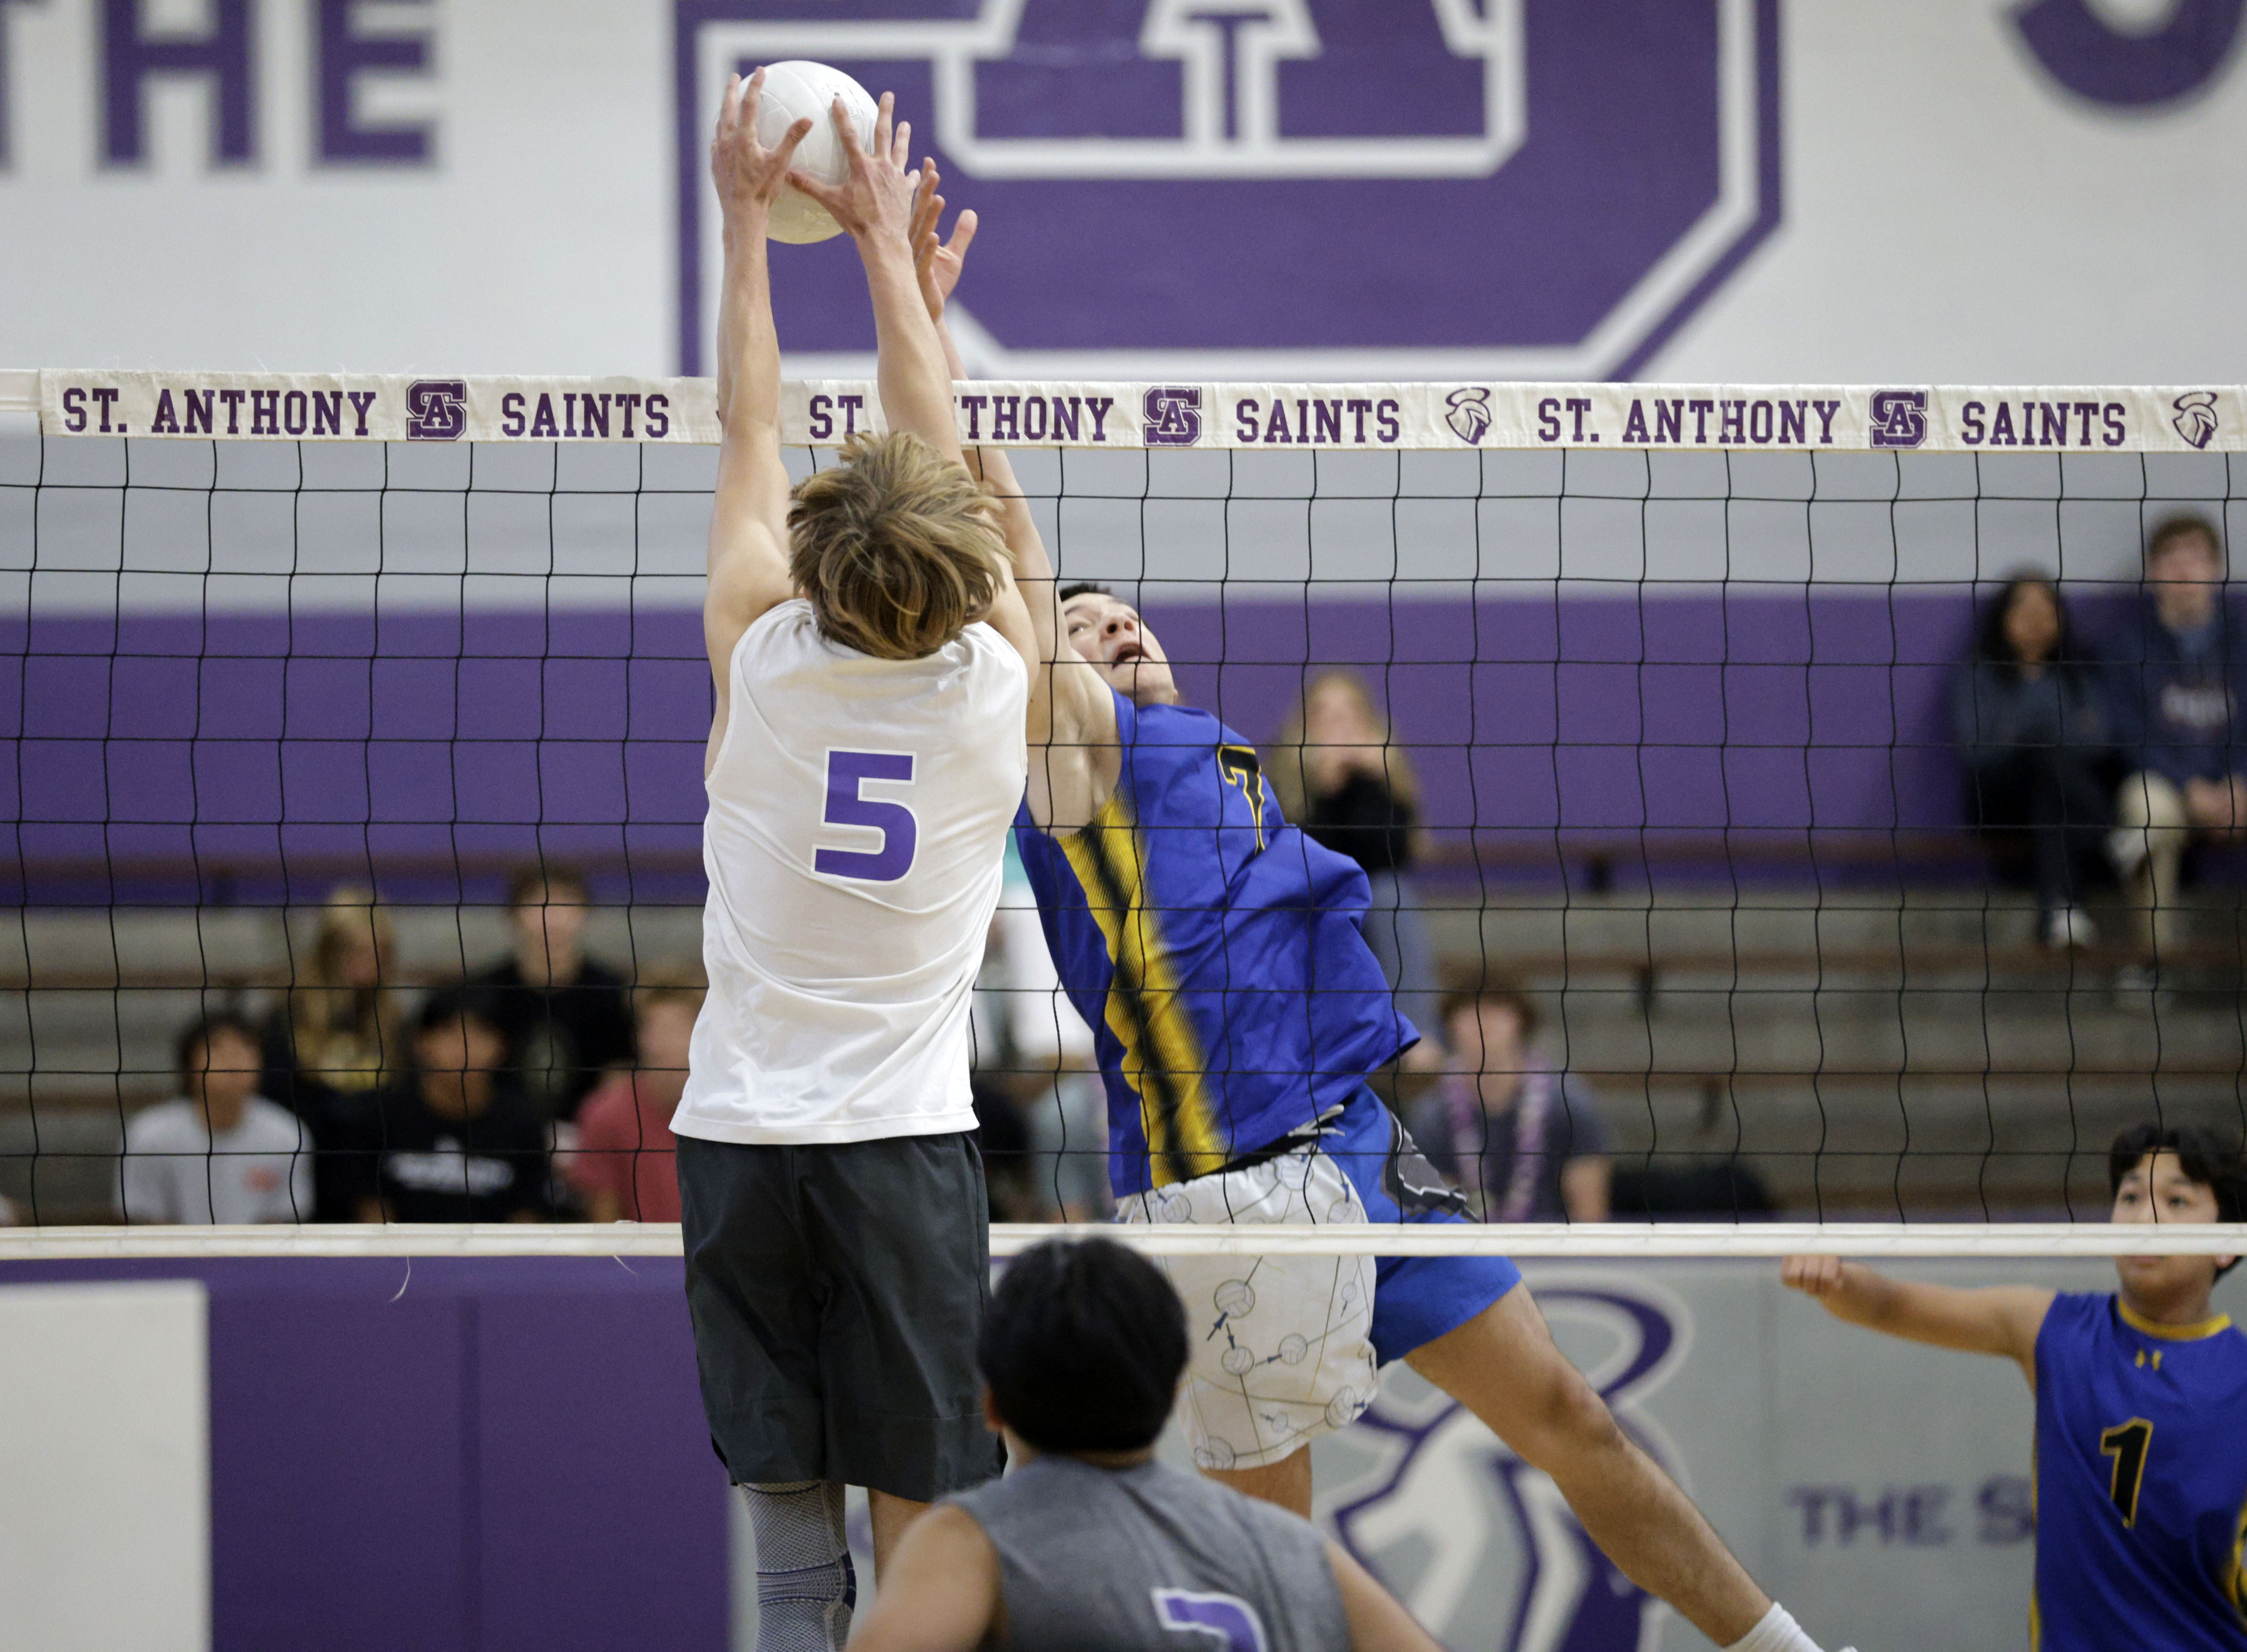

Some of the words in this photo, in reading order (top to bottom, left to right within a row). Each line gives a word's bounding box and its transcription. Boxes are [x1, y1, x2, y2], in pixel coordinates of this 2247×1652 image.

[0, 0, 437, 171] HE
[64, 388, 127, 433] ST.
[151, 389, 377, 437] ANTHONY
[502, 393, 670, 438] SAINTS
[809, 395, 871, 439] ST
[953, 395, 1114, 442] THONY
[1236, 399, 1400, 444] SAINTS
[1538, 398, 1599, 442] ST.
[1621, 400, 1841, 445] ANTHONY
[1961, 401, 2126, 447] SAINTS
[812, 748, 919, 884] 5
[1217, 744, 1266, 856] 7
[2101, 1416, 2153, 1529] 1
[1786, 1484, 1953, 1548] THE
